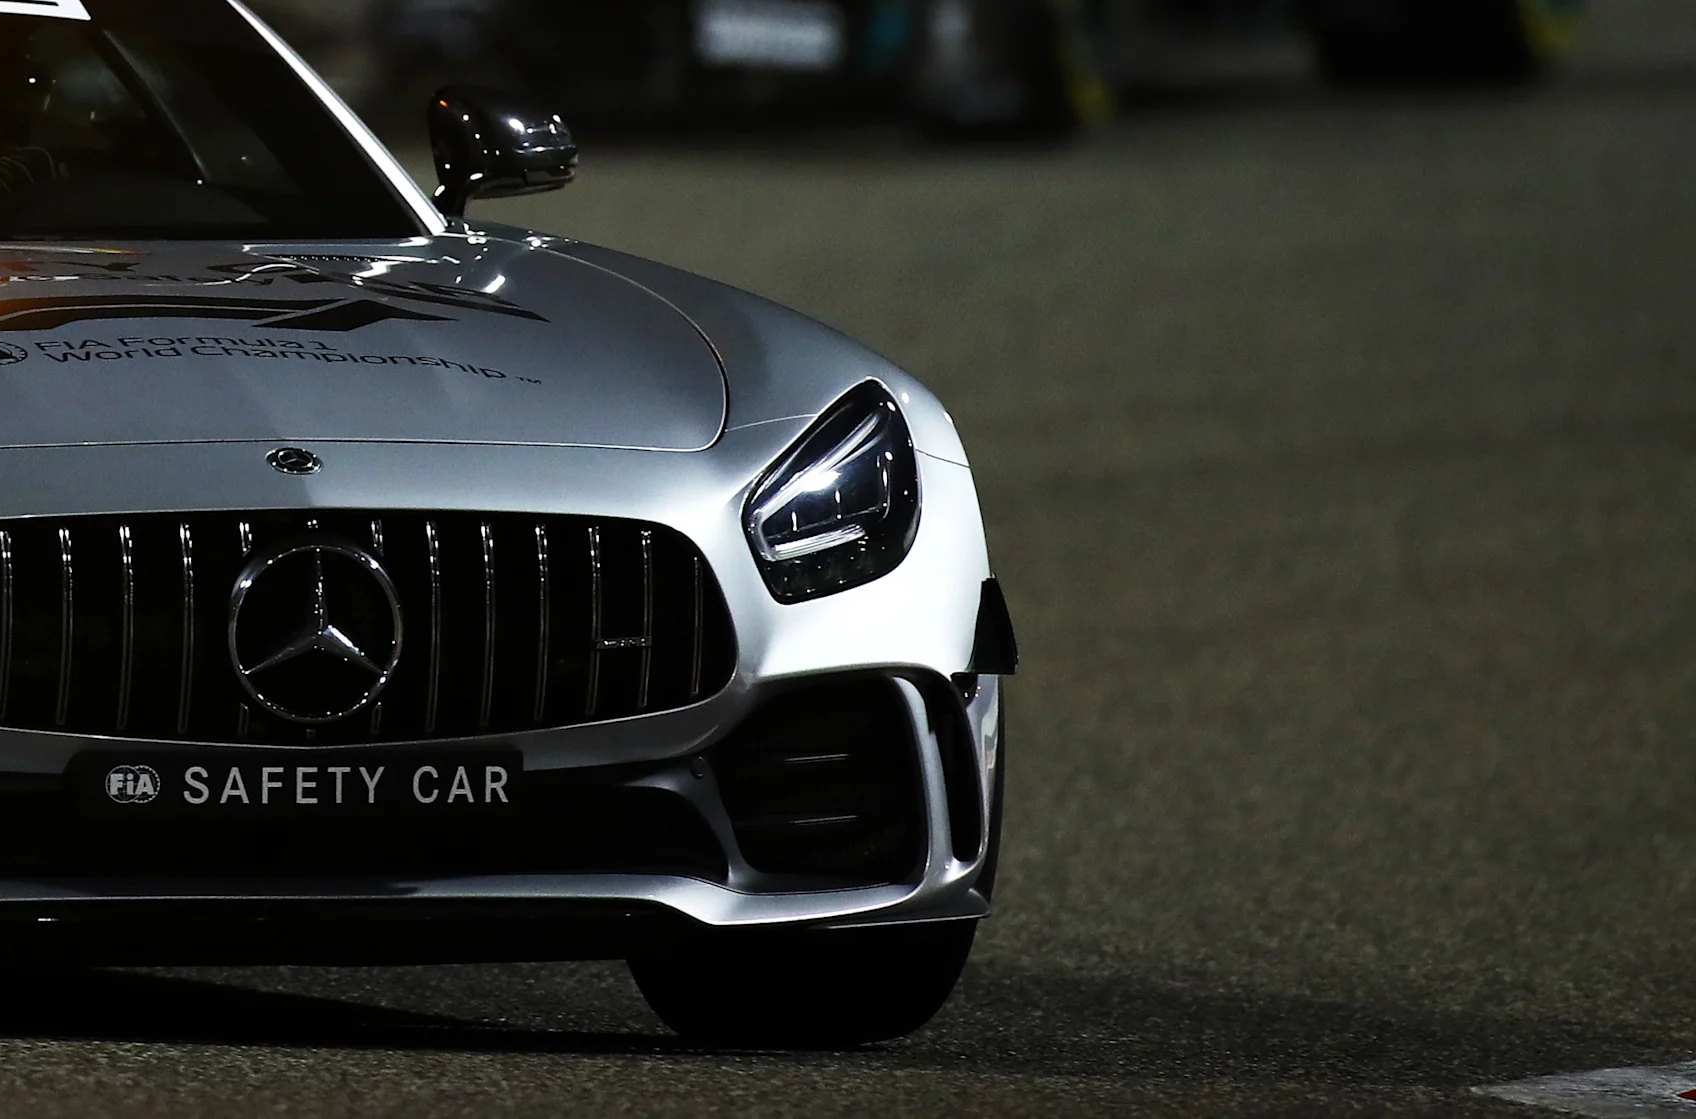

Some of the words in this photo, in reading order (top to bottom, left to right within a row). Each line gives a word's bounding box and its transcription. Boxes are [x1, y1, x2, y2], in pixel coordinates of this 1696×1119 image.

[34, 338, 113, 353] FIA
[117, 336, 305, 351] Formula
[308, 340, 338, 352] 1
[44, 346, 180, 363] World
[190, 345, 507, 379] Championship
[182, 765, 385, 805] SAFETY
[411, 765, 510, 804] CAR
